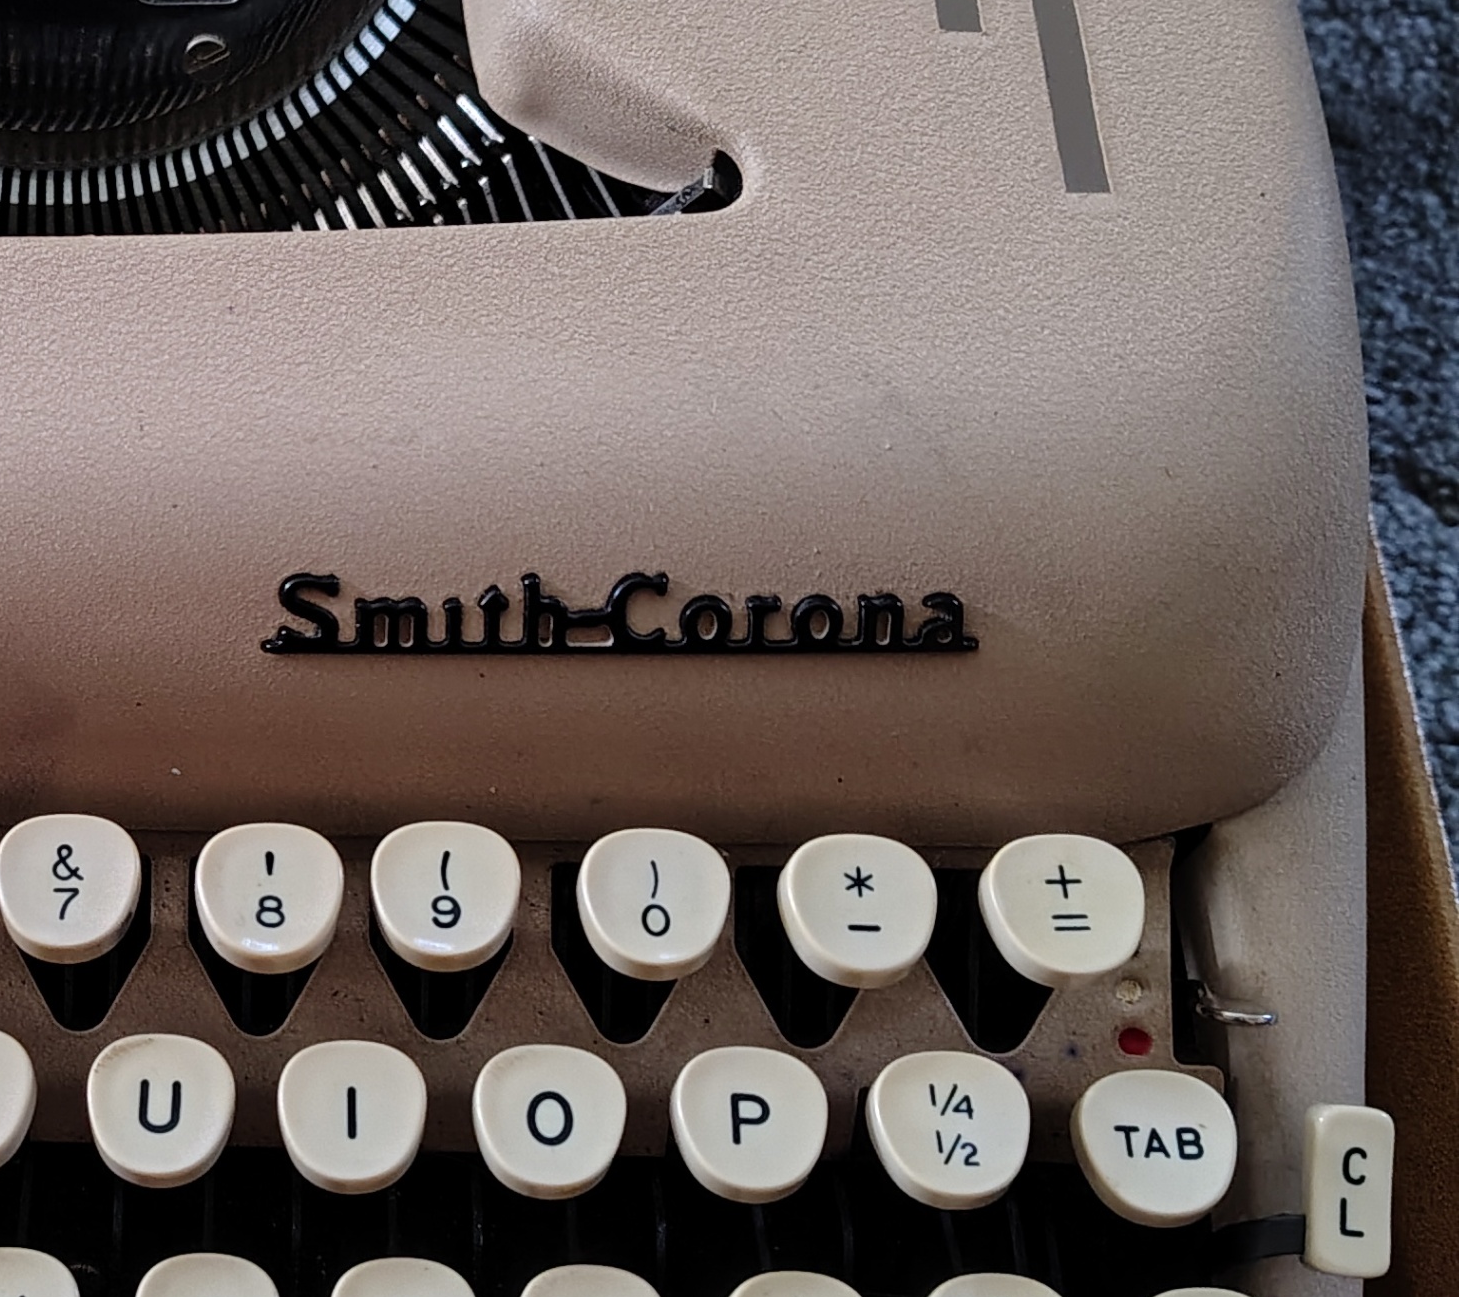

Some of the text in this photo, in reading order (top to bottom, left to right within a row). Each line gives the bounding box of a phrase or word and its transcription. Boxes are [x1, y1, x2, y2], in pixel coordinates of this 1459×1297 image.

[261, 572, 980, 655] Smith-Corona
[51, 843, 85, 882] &
[52, 886, 81, 922] 7
[254, 894, 287, 930] 8
[430, 894, 463, 930] 9
[137, 1077, 183, 1135] U
[345, 1085, 358, 1141] I
[525, 1089, 575, 1148] O
[729, 1091, 772, 1146] P
[1112, 1124, 1205, 1162] TAB
